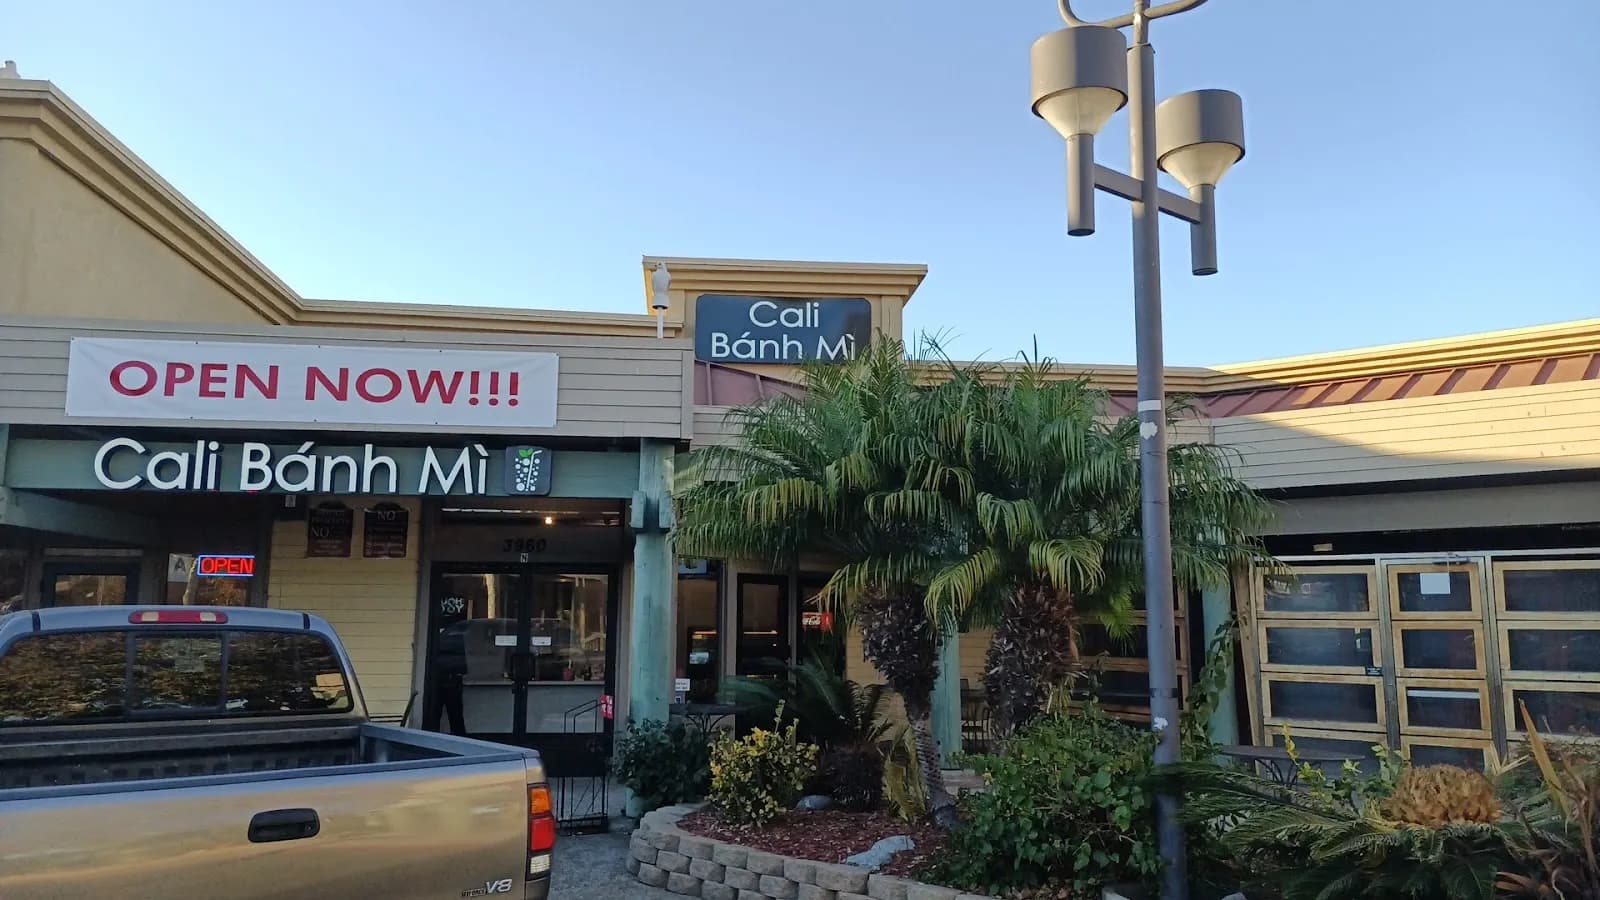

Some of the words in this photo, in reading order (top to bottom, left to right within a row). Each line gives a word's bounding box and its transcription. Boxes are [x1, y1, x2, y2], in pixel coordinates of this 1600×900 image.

[749, 301, 819, 327] Cali
[711, 332, 803, 359] Bánh
[815, 333, 856, 361] Mì
[110, 360, 279, 399] OPEN
[305, 366, 520, 407] NOW!!!
[94, 438, 221, 490] Cali
[240, 442, 398, 492] Bánh
[418, 445, 489, 496] Mì
[503, 538, 547, 552] 3960
[201, 557, 254, 574] OPEN
[486, 878, 513, 893] V8
